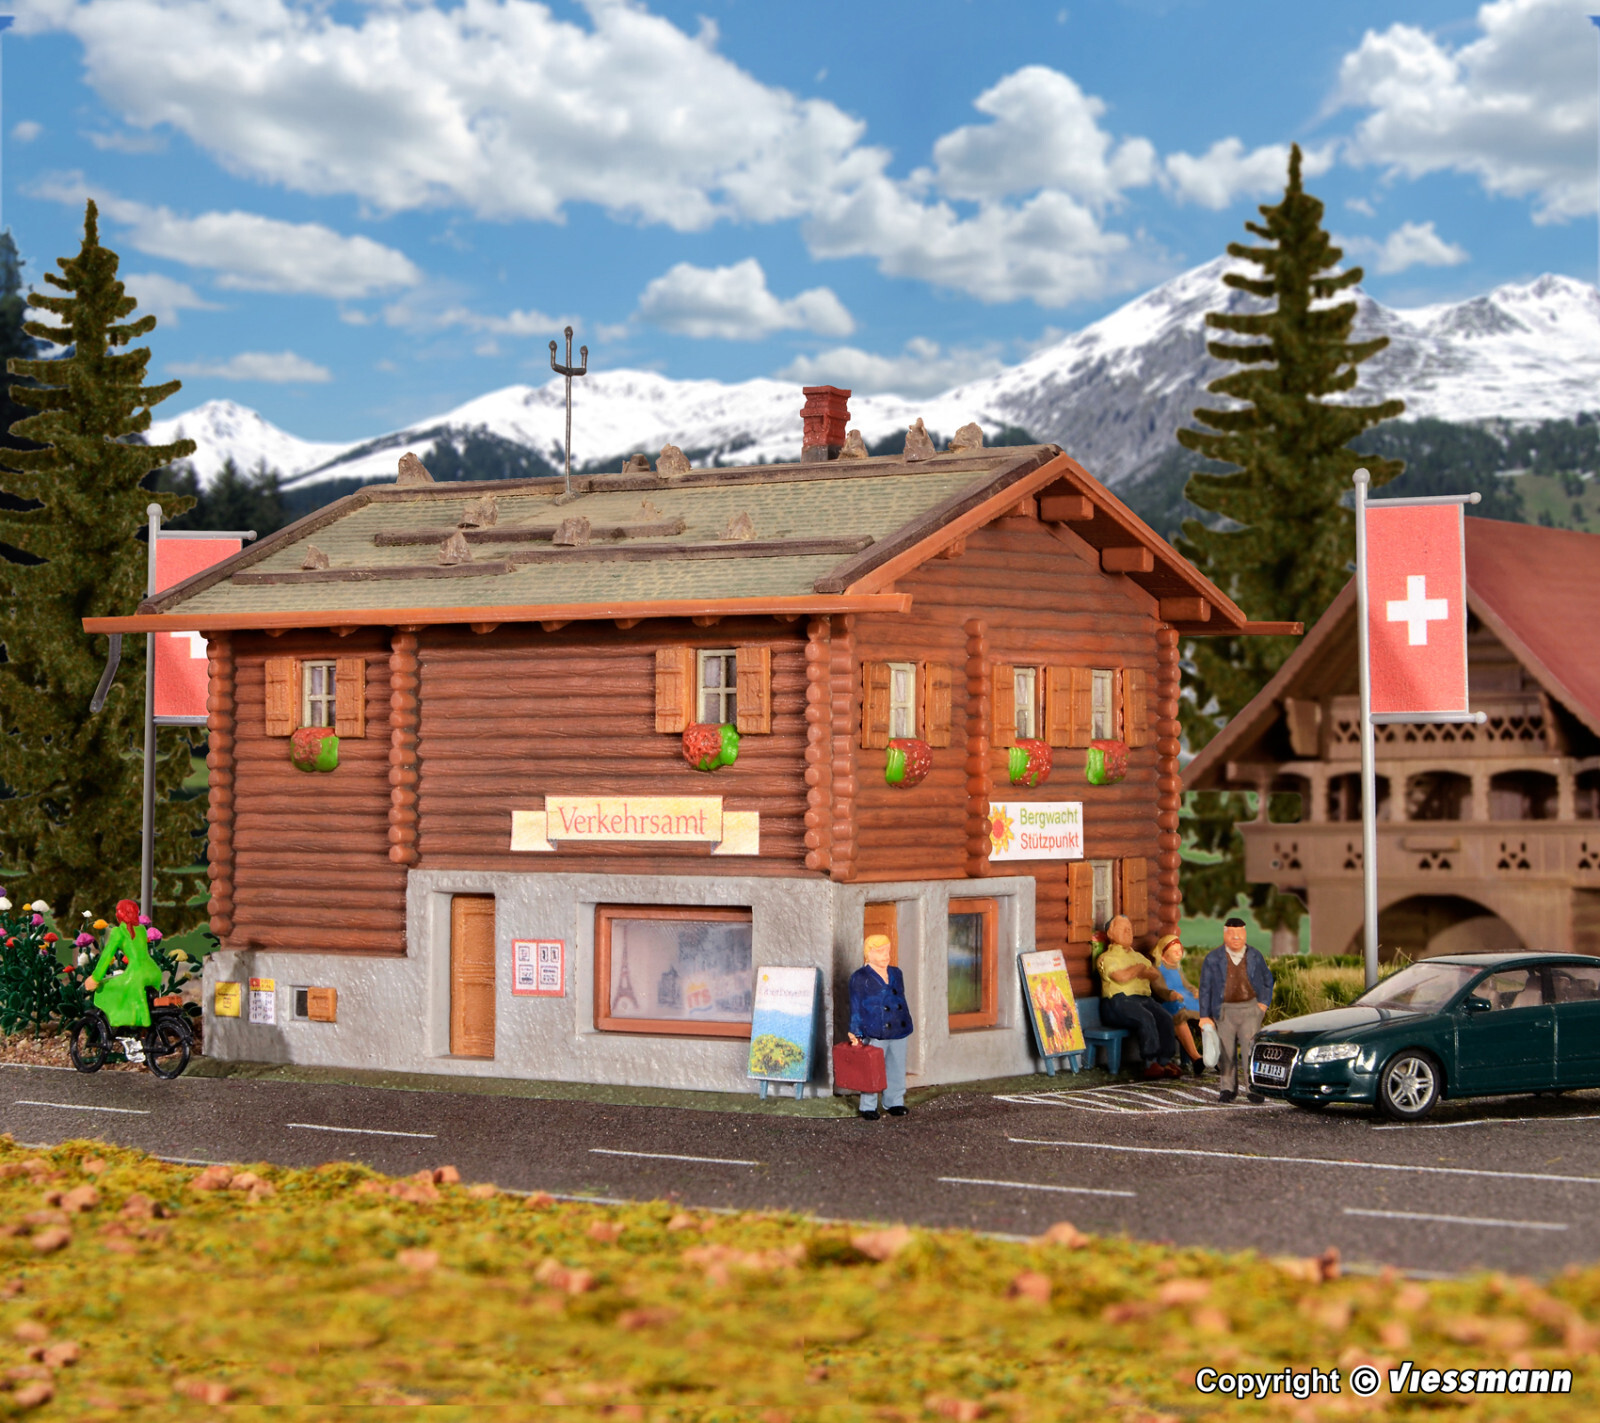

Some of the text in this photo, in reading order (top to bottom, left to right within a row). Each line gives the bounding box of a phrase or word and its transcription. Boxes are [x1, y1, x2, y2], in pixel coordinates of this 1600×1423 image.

[557, 803, 708, 835] Verkehrsamt
[1020, 807, 1078, 829] Bergwacht
[1020, 831, 1079, 852] Stützpunkt
